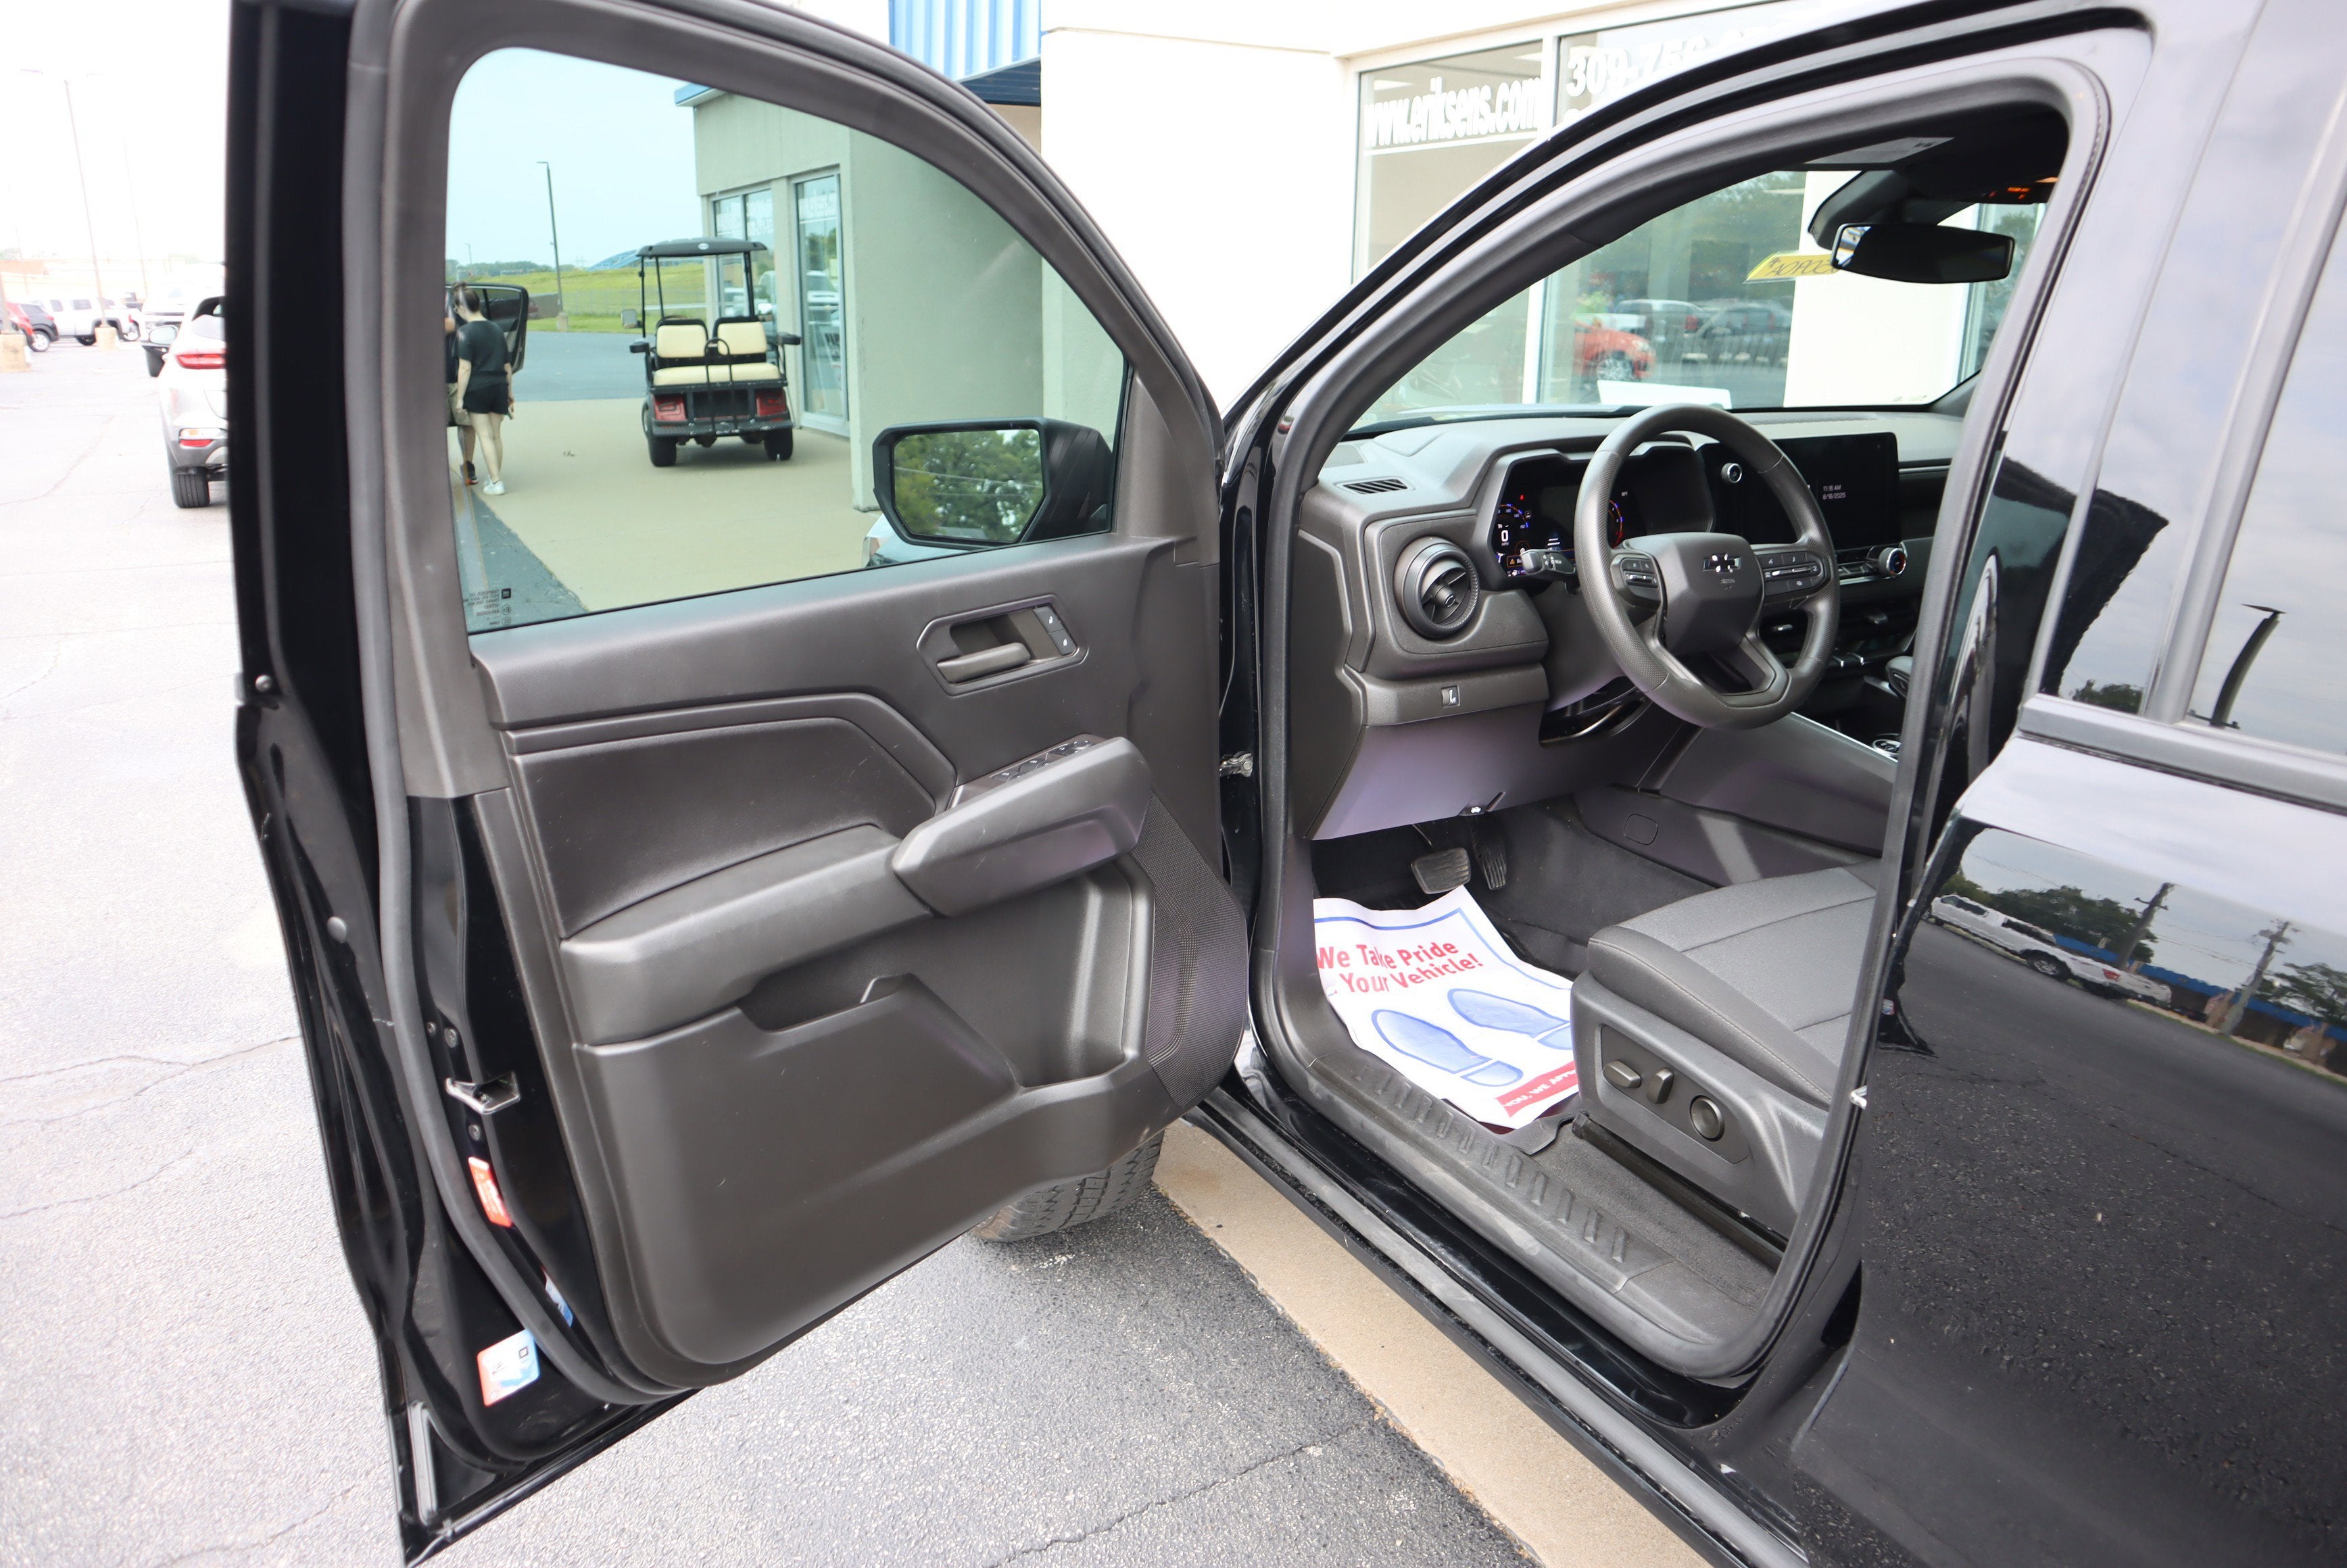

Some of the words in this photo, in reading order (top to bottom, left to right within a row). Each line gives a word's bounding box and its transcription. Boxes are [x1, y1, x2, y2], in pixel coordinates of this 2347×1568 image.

[1363, 76, 1541, 148] www.eriksens.com
[1316, 946, 1351, 969] We
[1355, 944, 1397, 969] Take
[1396, 941, 1459, 966] Pride
[1338, 973, 1389, 994] Your
[1389, 953, 1483, 988] Vehicle!
